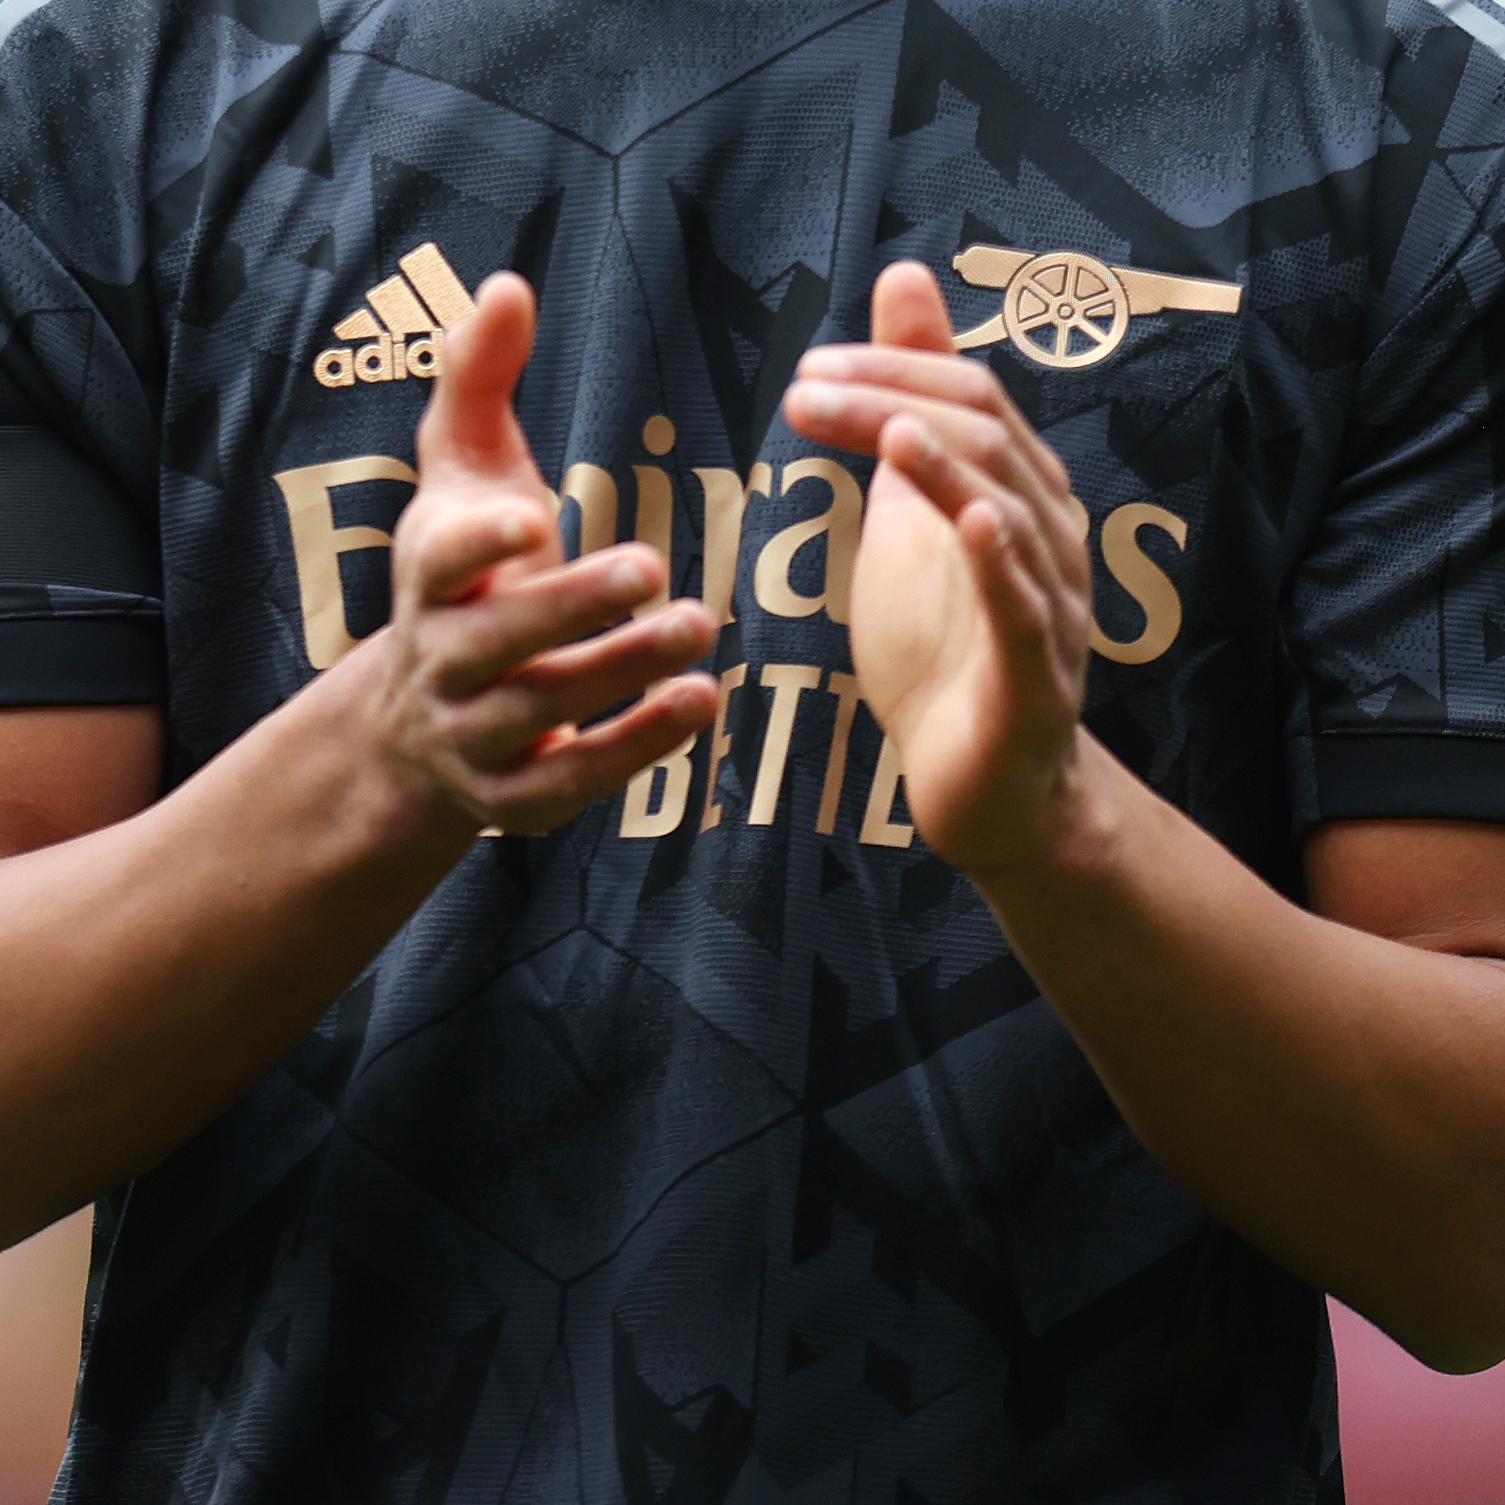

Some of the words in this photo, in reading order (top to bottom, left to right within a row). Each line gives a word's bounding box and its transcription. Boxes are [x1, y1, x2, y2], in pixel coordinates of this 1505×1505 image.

[312, 328, 445, 388] adid
[274, 415, 1188, 670] Eiras
[618, 663, 915, 849] BETTE
